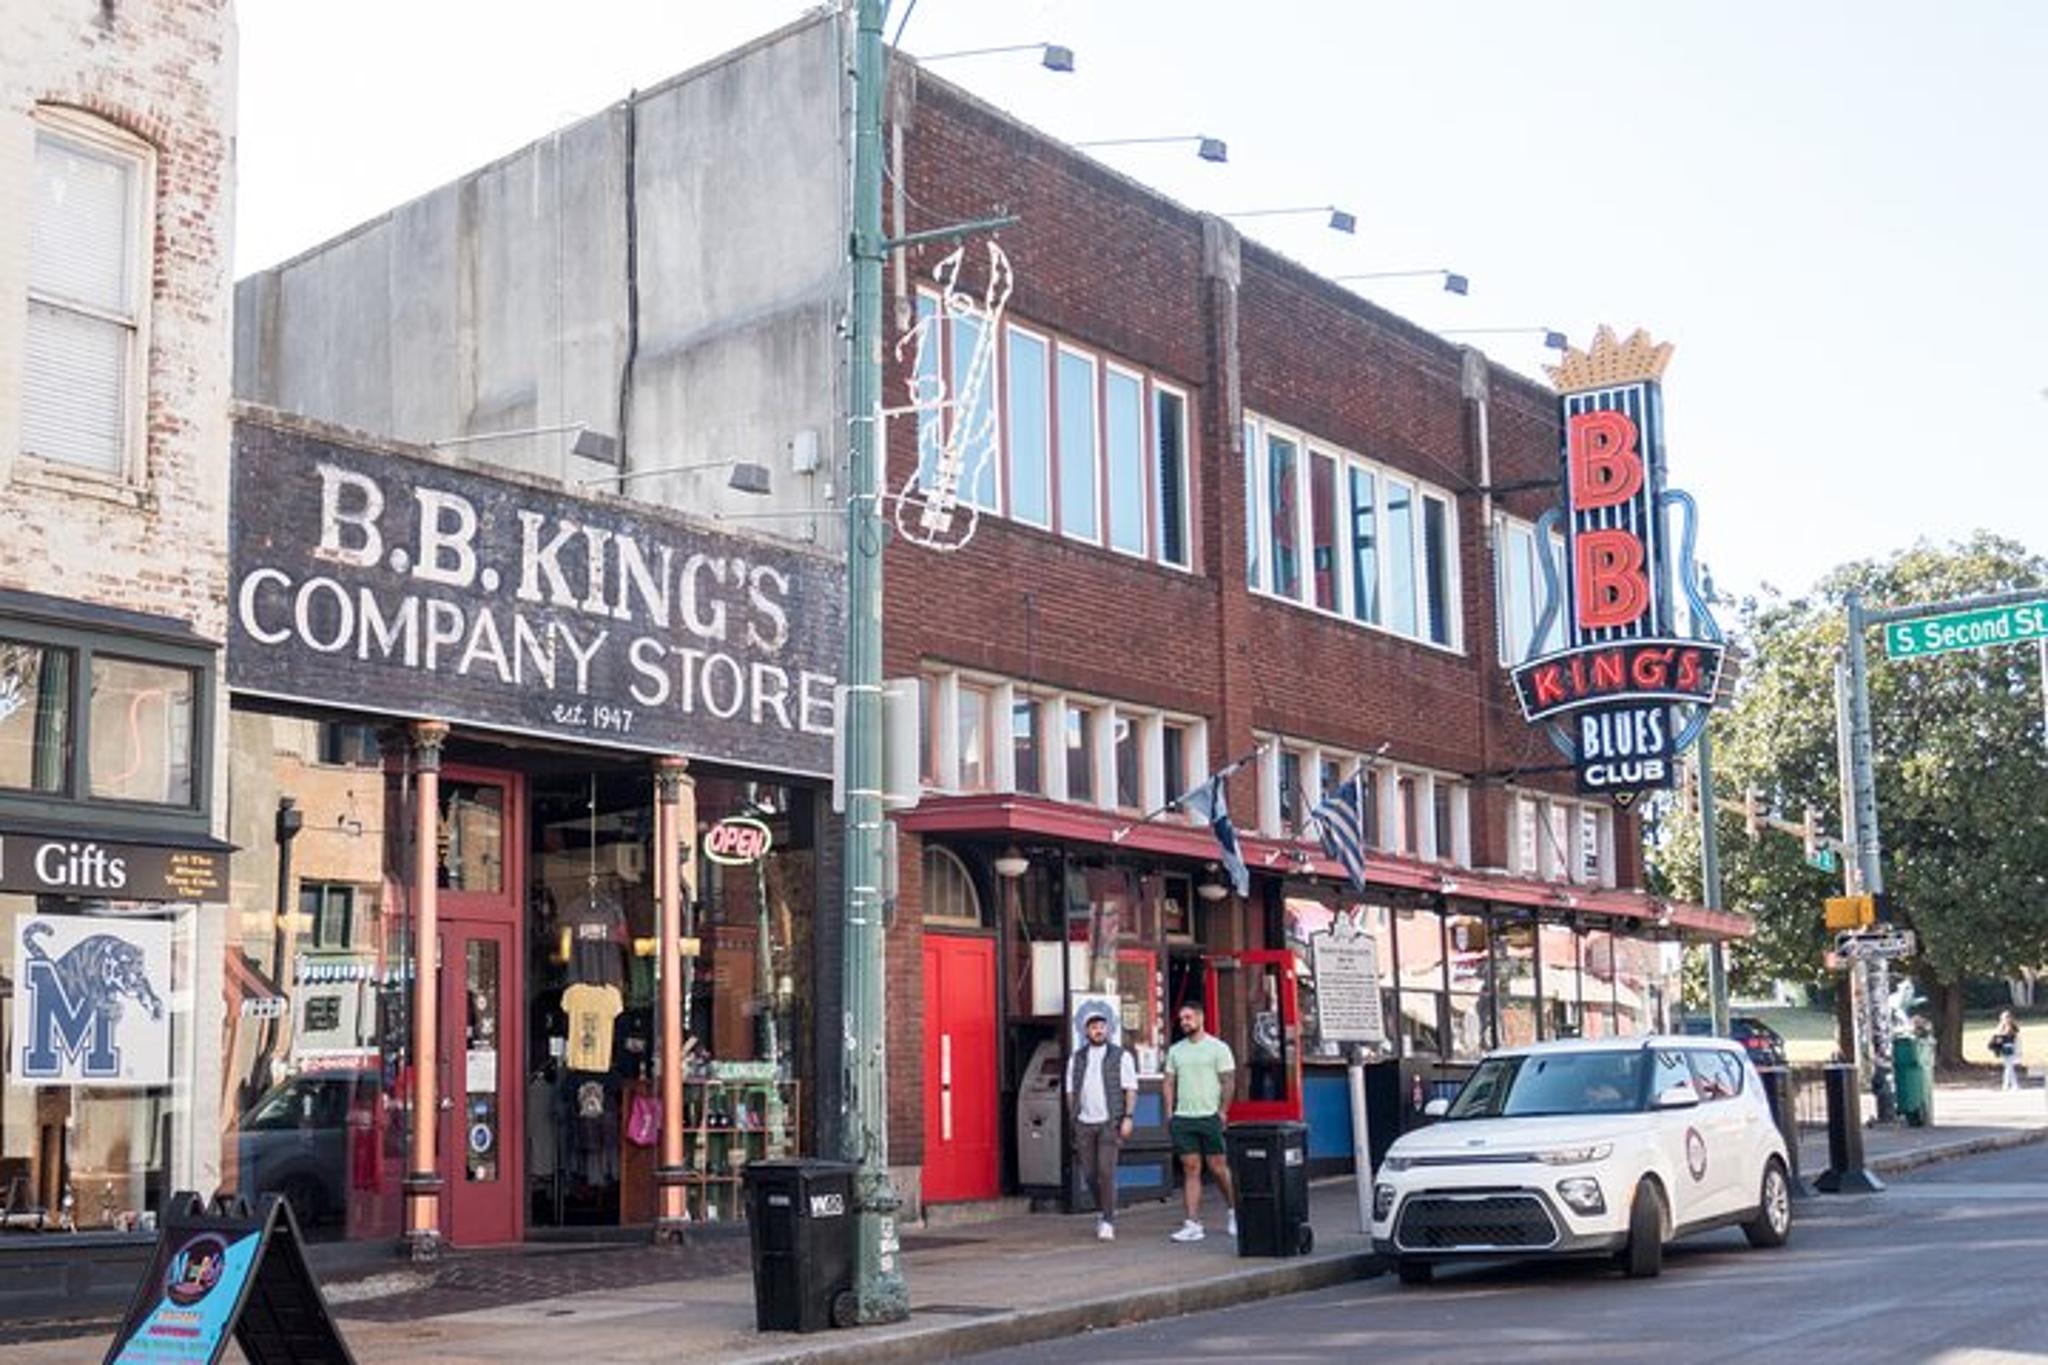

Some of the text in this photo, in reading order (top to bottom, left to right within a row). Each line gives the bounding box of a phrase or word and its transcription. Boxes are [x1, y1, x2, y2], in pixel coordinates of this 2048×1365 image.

[1568, 410, 1644, 511] B
[313, 461, 791, 654] B.B. KING'S
[1575, 527, 1650, 629] B
[237, 567, 839, 736] COMPANY STORE
[1924, 611, 2010, 650] Second
[2014, 608, 2048, 636] St
[1533, 647, 1703, 708] KING'S
[551, 703, 633, 733] est. 1947
[1581, 706, 1665, 758] BLUES
[1584, 758, 1665, 787] CLUB
[35, 843, 126, 888] Gifts
[710, 824, 764, 859] OPEN
